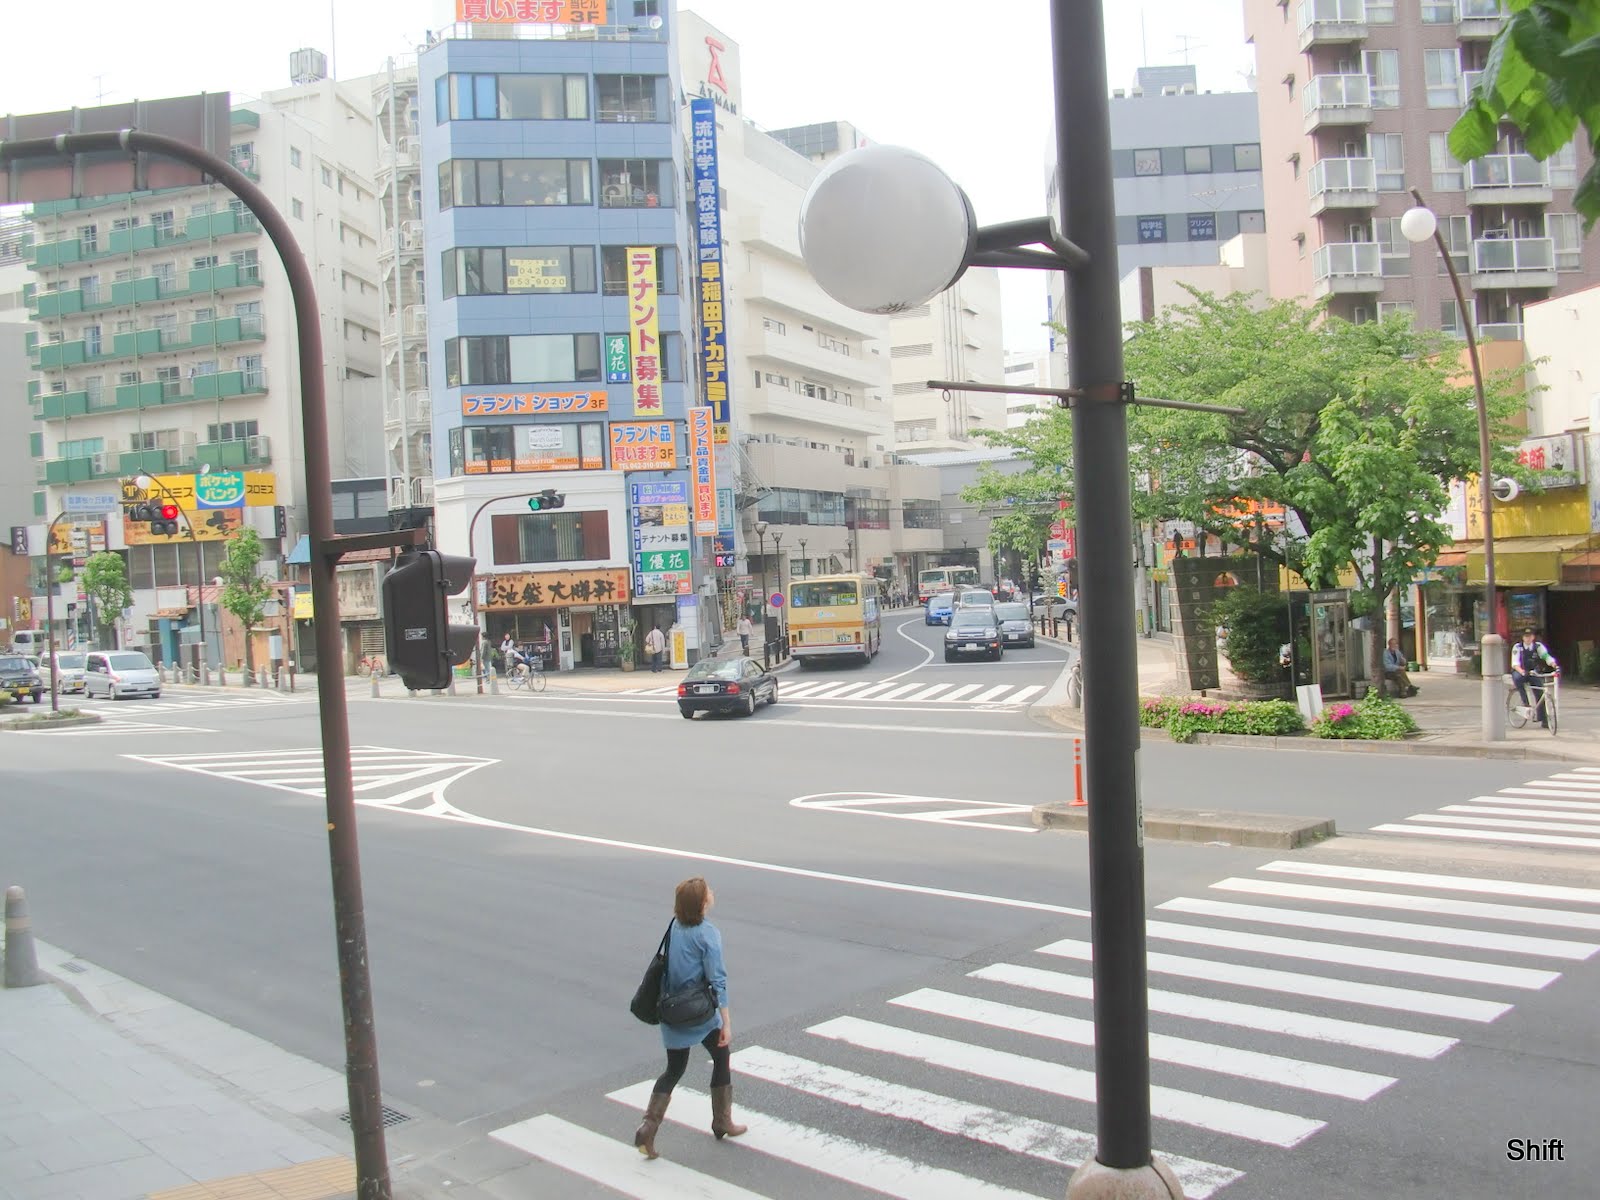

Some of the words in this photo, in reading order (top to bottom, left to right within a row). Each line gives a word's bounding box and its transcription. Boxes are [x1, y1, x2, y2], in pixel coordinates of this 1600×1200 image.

[463, 0, 565, 21] 買います
[570, 11, 599, 23] 3F
[694, 109, 718, 246] 一流中学・高校受験
[631, 252, 661, 409] テナント募集
[701, 261, 727, 421] 早稲田アカデミー
[609, 338, 627, 371] 優花
[466, 395, 526, 414] ブランド
[531, 391, 591, 411] ショップ
[590, 399, 605, 409] 3F
[613, 424, 671, 443] ブランド品
[694, 410, 709, 456] ブランド品
[614, 445, 659, 462] 買います
[659, 448, 674, 459] 3F
[200, 474, 241, 487] ポケット
[698, 458, 710, 483] 貴金属
[151, 487, 194, 499] プロミス
[205, 488, 238, 500] バンク
[247, 484, 274, 494] プロミス
[699, 485, 711, 519] 買います
[641, 532, 689, 543] テナント募集
[649, 552, 684, 570] 優花
